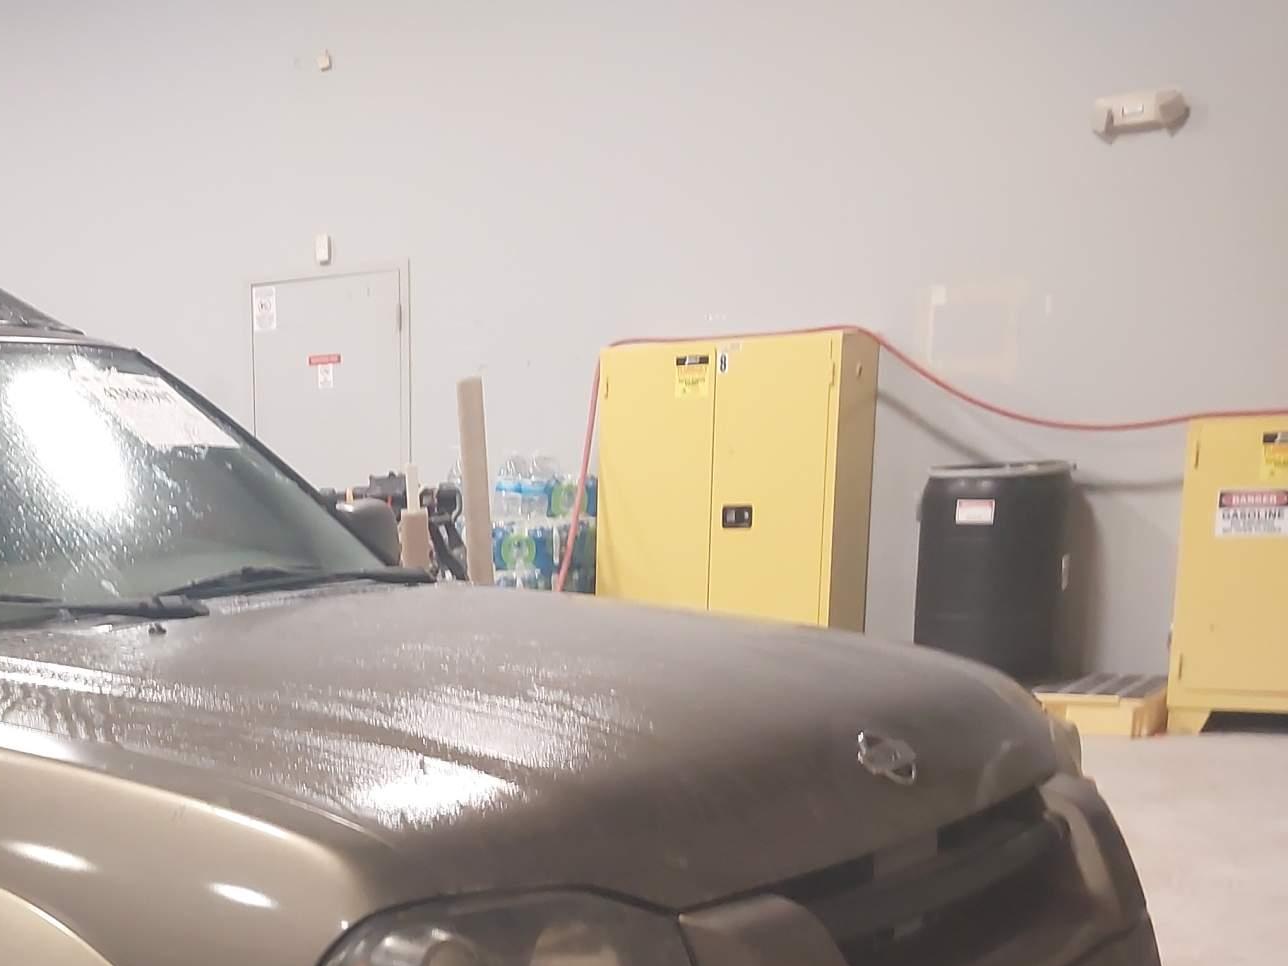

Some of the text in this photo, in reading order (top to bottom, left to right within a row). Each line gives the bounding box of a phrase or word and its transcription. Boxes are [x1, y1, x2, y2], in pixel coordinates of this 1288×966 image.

[720, 353, 727, 373] 8
[1231, 494, 1278, 505] DANGER
[1222, 509, 1284, 521] GASOLINE
